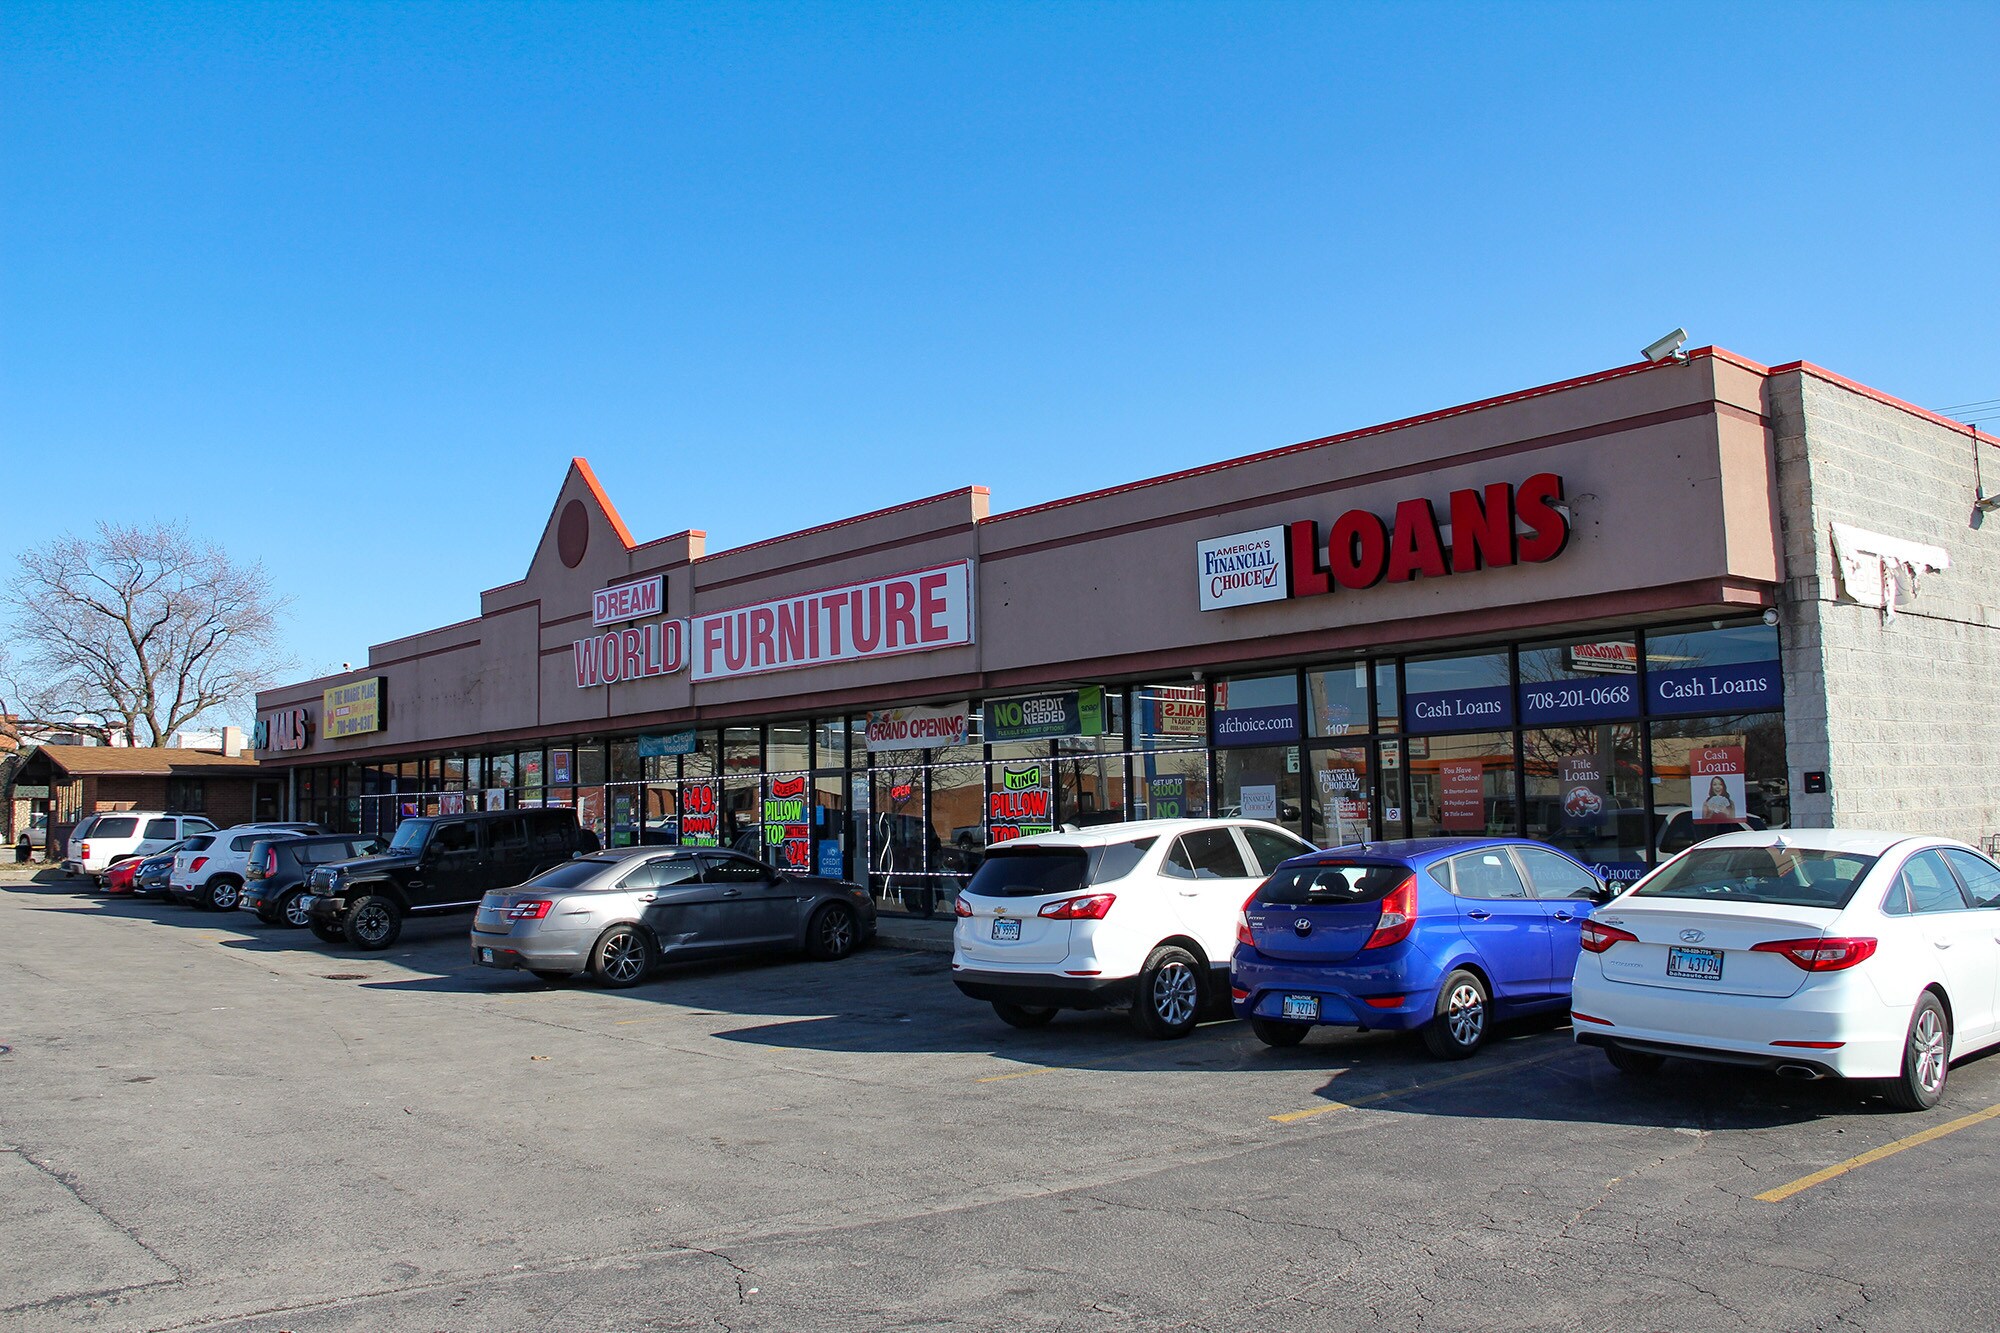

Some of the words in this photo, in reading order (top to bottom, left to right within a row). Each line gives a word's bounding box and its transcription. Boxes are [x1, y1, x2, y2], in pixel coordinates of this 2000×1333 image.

[1291, 472, 1569, 597] LOANS
[1216, 540, 1271, 557] AMERICA'S
[1205, 550, 1275, 575] FINANCIAL
[1211, 570, 1263, 599] CHOICE
[597, 582, 657, 620] DREAM
[702, 572, 950, 674] FURNITURE
[573, 617, 686, 689] WORLD
[1659, 678, 1705, 699] Cash
[1709, 677, 1768, 695] Loans
[1527, 685, 1630, 710] 708-201-0668
[994, 702, 1022, 727] NO
[1022, 698, 1064, 714] CREDIT
[1415, 700, 1452, 718] Cash
[1456, 699, 1501, 716] Loans
[1023, 710, 1066, 725] NEEDED
[1219, 717, 1294, 734] afchoice.com
[269, 708, 307, 752] NAILS
[870, 720, 908, 741] GRAND
[909, 715, 964, 739] OPENING
[1326, 723, 1350, 735] 1107
[1703, 750, 1728, 760] Cash
[1443, 767, 1455, 775] You
[1456, 766, 1472, 774] Have
[1571, 760, 1591, 769] Title
[1697, 761, 1737, 774] Loans
[1010, 771, 1037, 788] KING
[1319, 770, 1357, 783] FINANCIAL
[1457, 774, 1481, 782] Choice!
[1564, 770, 1600, 782] Loans
[775, 784, 799, 795] QUEEN
[891, 785, 911, 798] OPEN
[1322, 780, 1352, 793] CHOICE
[764, 800, 802, 821] PILLOW
[989, 790, 1048, 819] PILLOW
[1156, 801, 1179, 817] NO
[682, 813, 717, 835] DOWN!
[765, 824, 785, 845] TOP
[822, 858, 841, 866] CREDIT
[820, 867, 842, 875] NEEDED
[1597, 864, 1641, 881] CHOICE
[1670, 955, 1682, 970] AT
[1688, 956, 1719, 974] 43794
